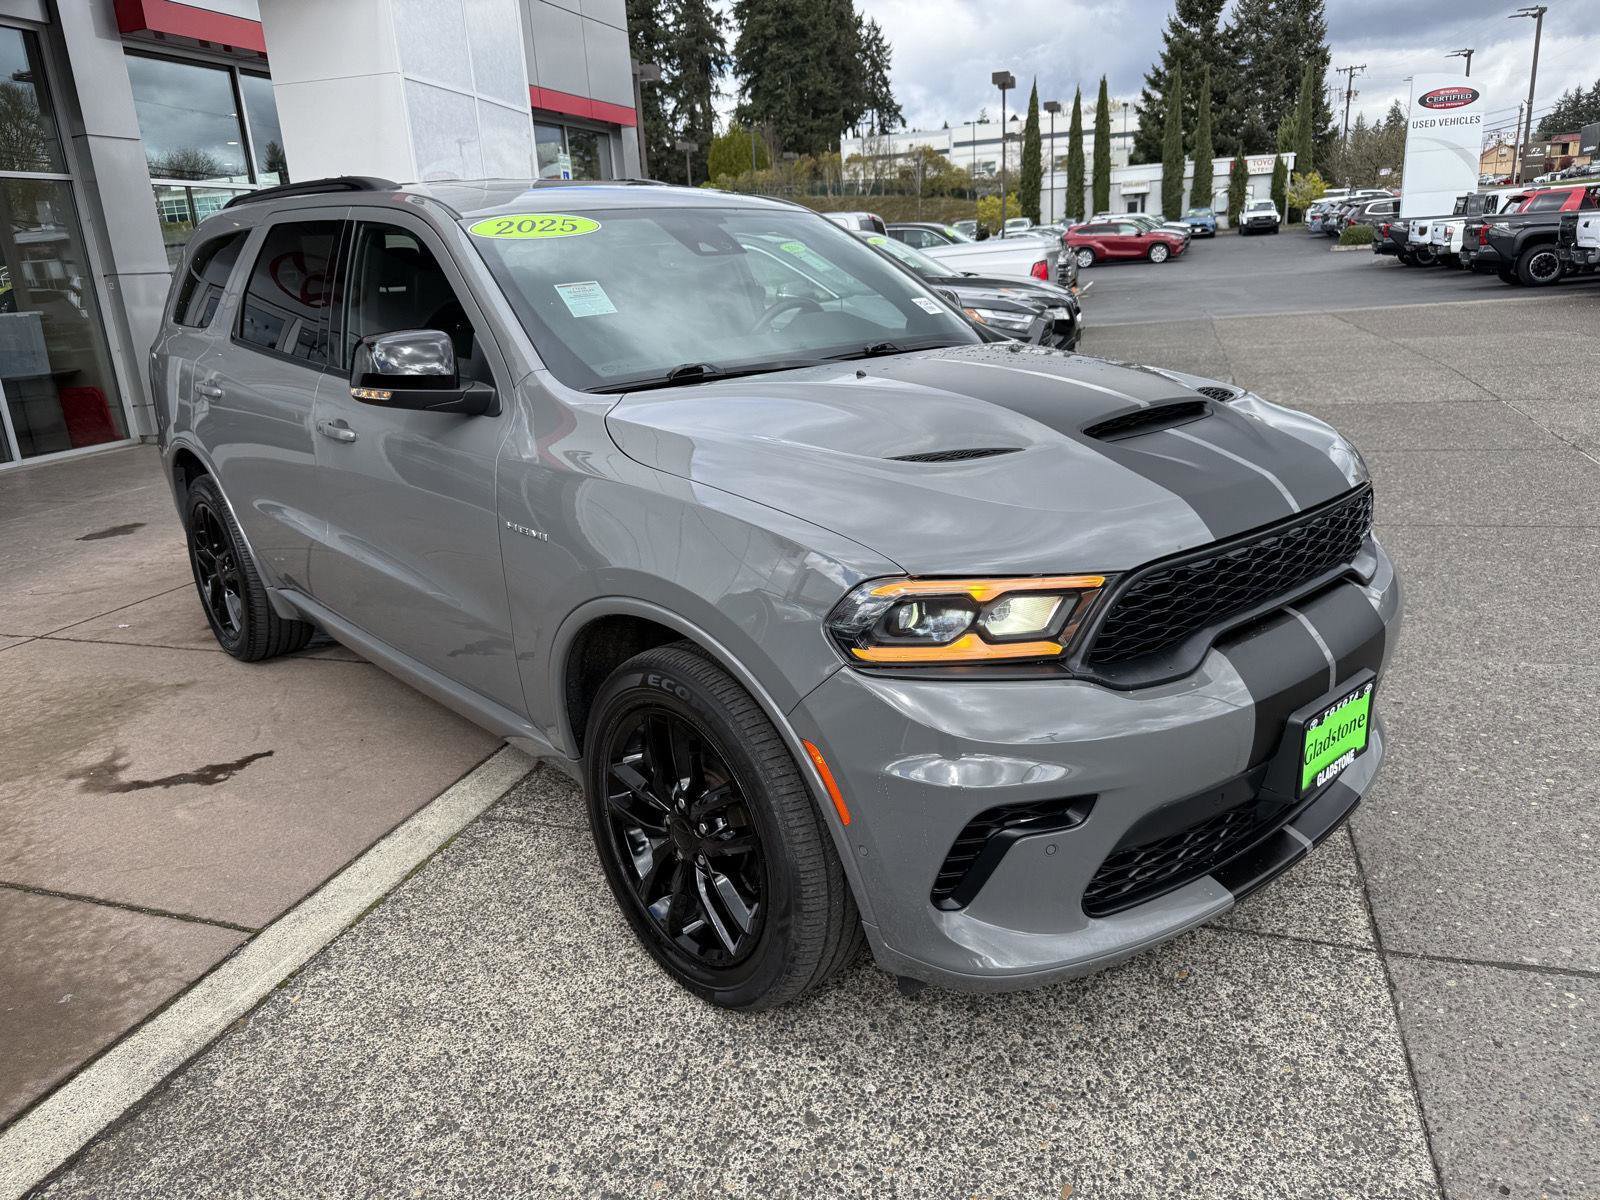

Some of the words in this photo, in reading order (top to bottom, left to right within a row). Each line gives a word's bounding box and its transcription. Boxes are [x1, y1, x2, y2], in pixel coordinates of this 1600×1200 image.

[1426, 94, 1472, 103] CERTIFIED
[1412, 119, 1436, 129] USED
[1438, 115, 1481, 127] VEHICLES
[496, 219, 578, 235] 2025
[1322, 690, 1360, 720] TOYOTA
[1304, 713, 1366, 767] Gladstone
[1316, 748, 1356, 788] GLADSTONE
